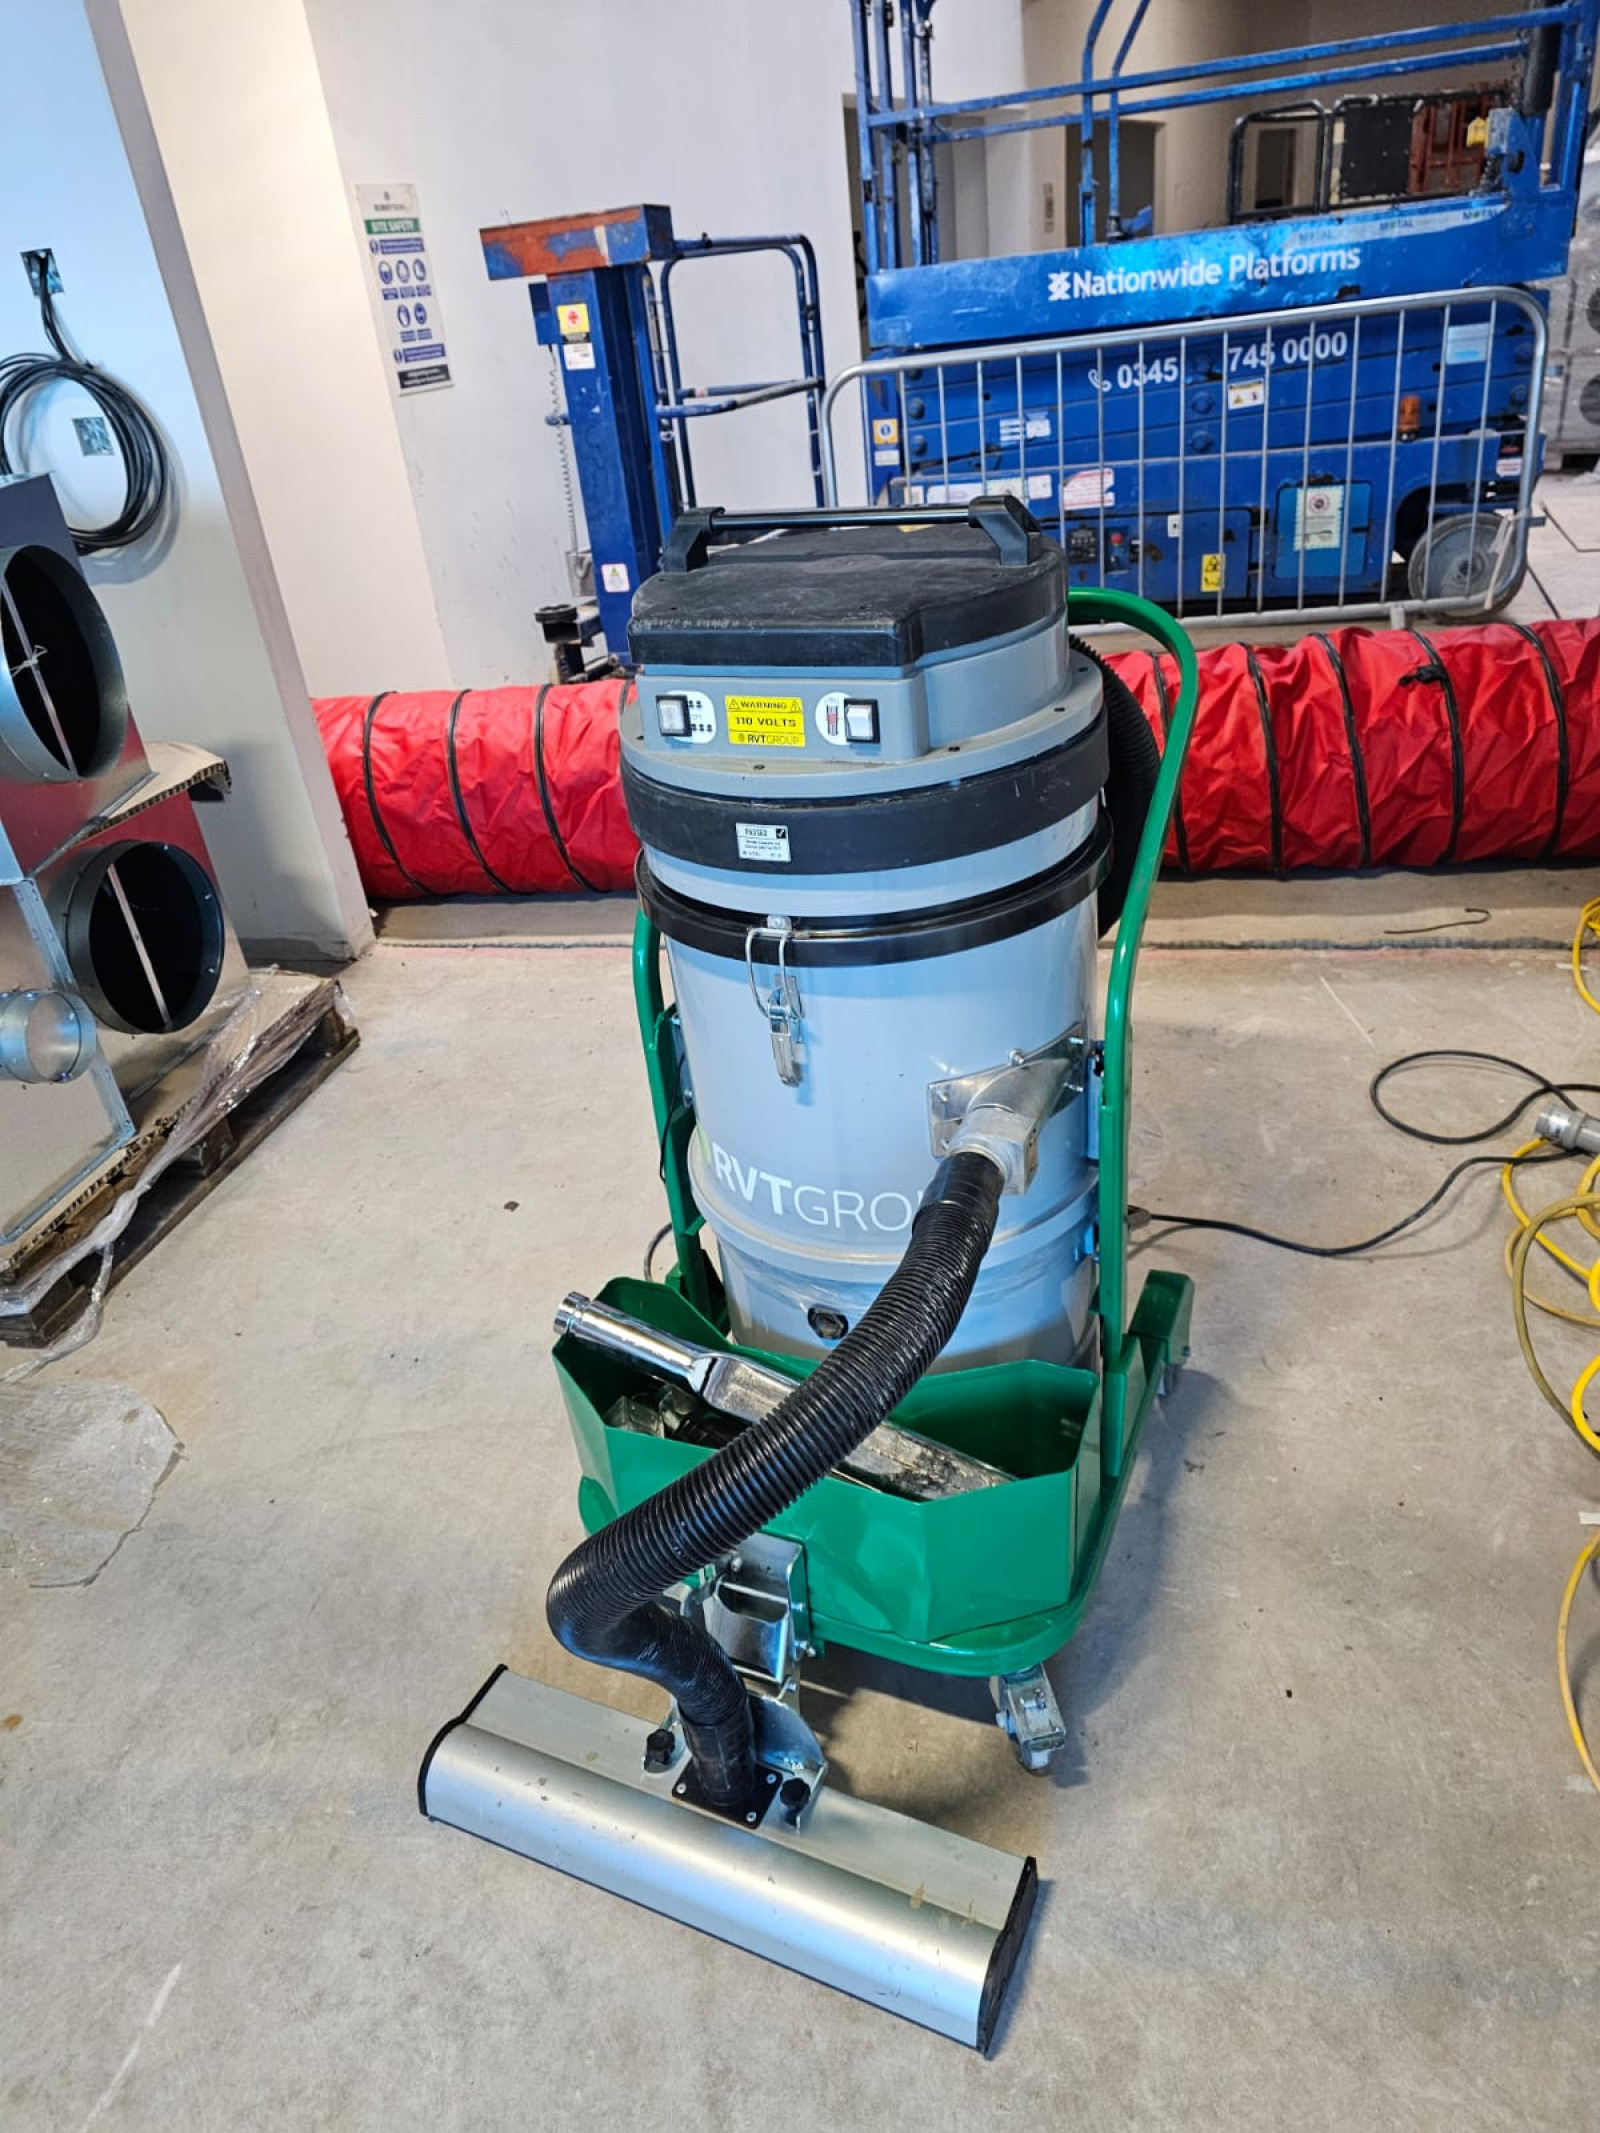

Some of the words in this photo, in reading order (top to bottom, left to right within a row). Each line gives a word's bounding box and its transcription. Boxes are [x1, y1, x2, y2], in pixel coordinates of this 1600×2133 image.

[1072, 256, 1221, 299] Nationwide
[1228, 248, 1361, 283] Platforms
[1116, 357, 1179, 389] 0345
[1228, 341, 1275, 372] 745
[1283, 331, 1348, 365] 0000
[736, 716, 753, 726] 110
[757, 717, 797, 728] VOLTS
[741, 700, 787, 710] WARNING
[711, 1141, 924, 1232] RVTGRO
